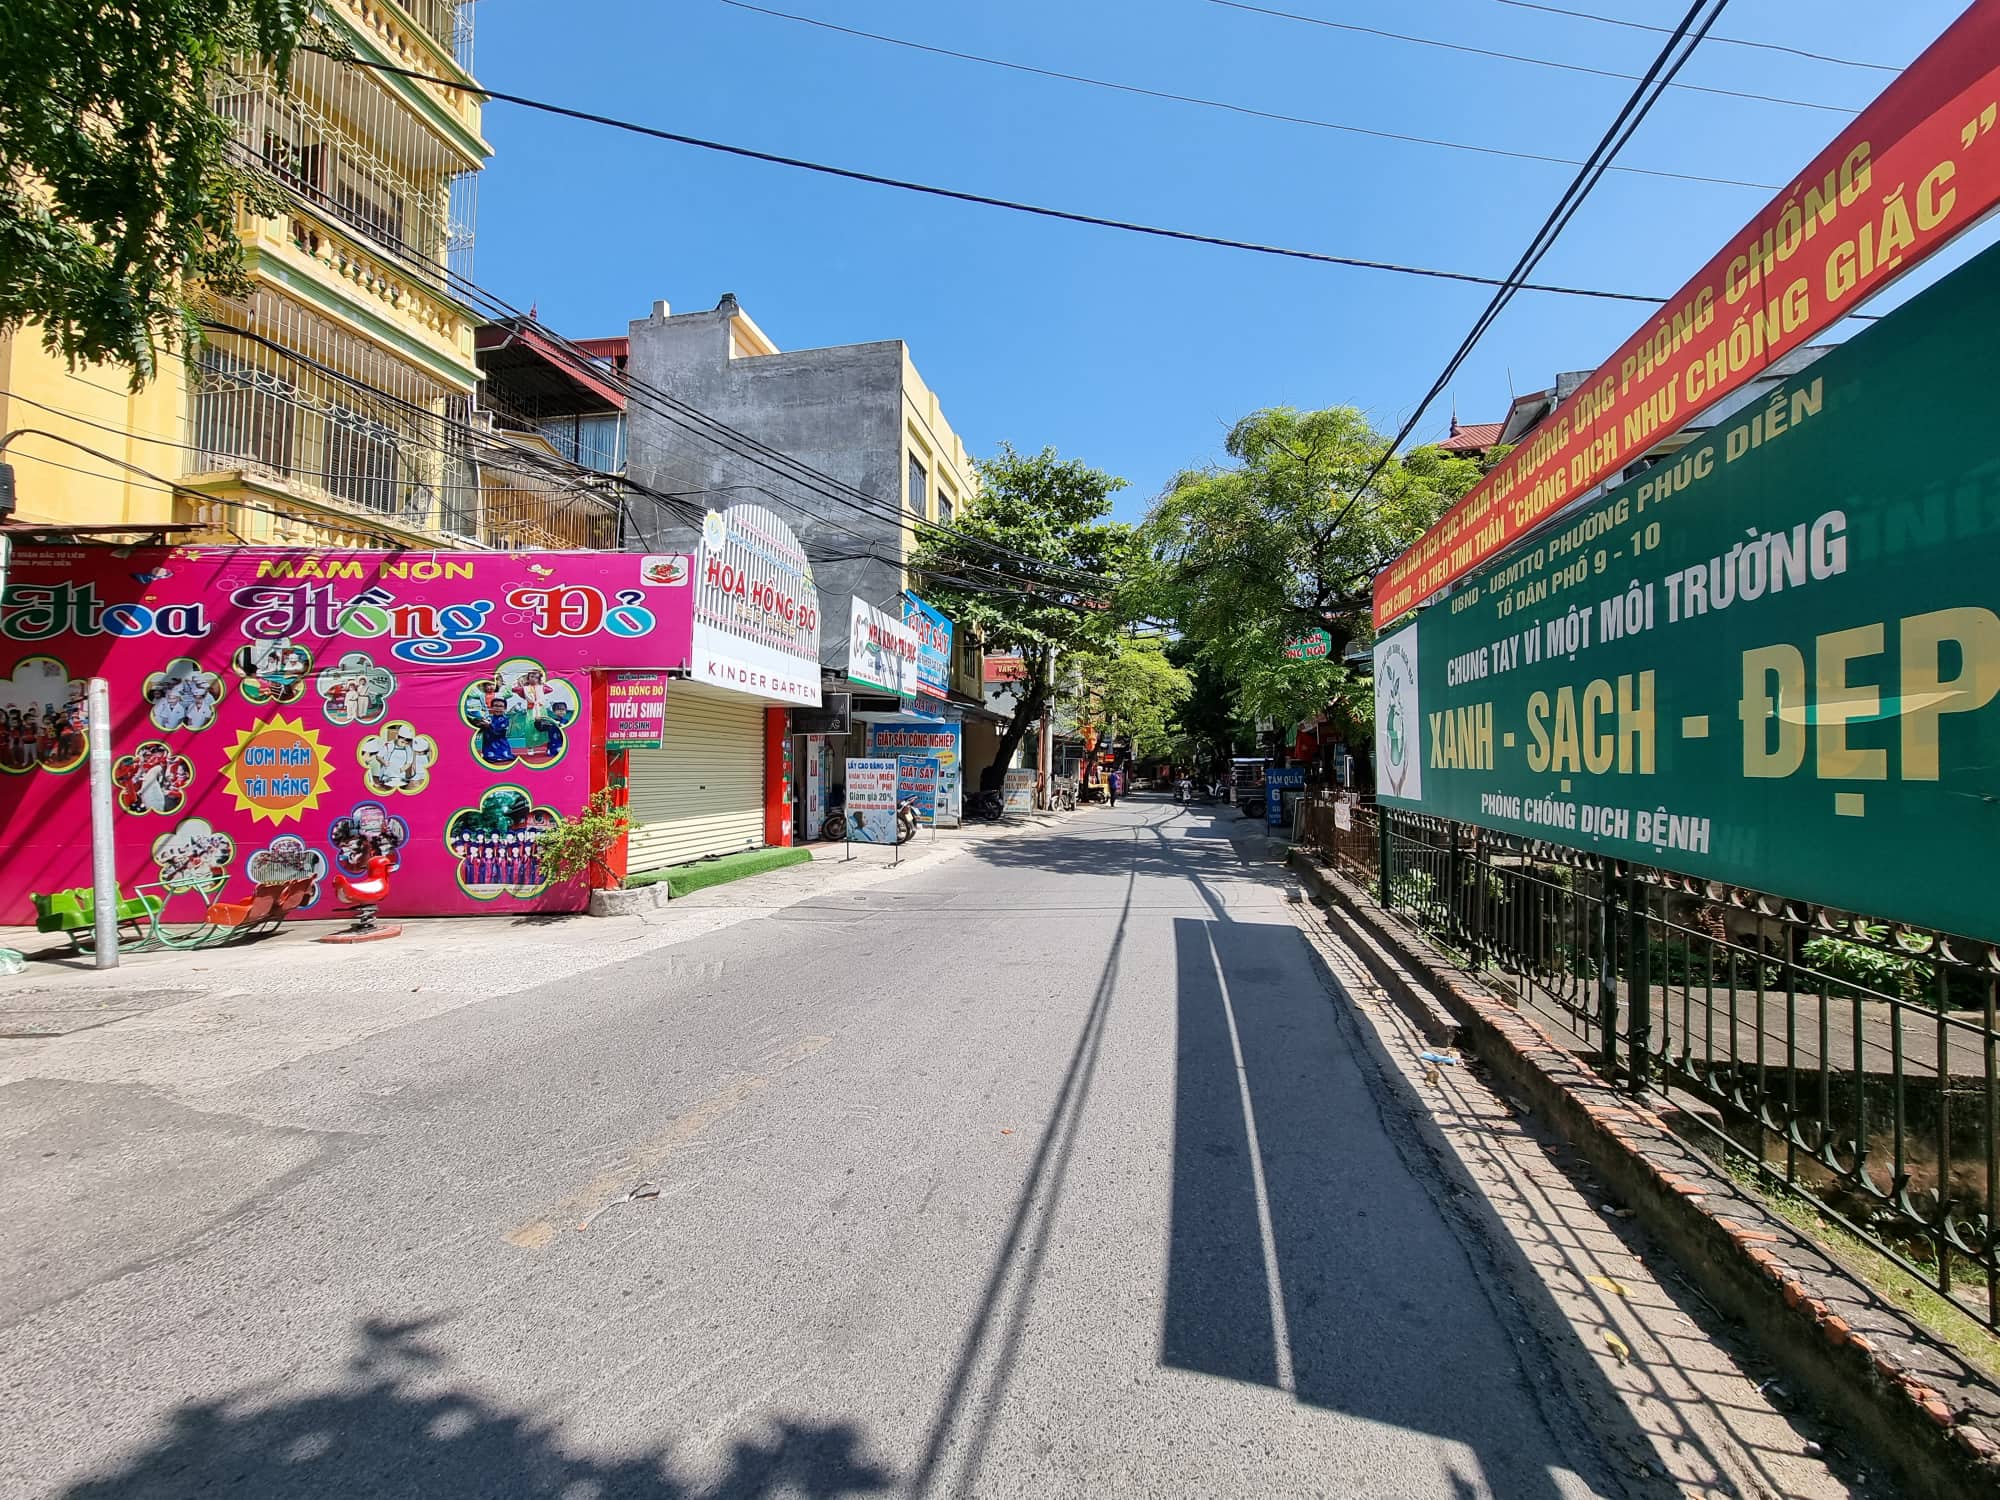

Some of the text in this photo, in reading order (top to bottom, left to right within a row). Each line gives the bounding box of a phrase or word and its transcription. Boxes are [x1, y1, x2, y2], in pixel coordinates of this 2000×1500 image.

[1423, 534, 1440, 562] TÍCH
[1441, 515, 1460, 546] CỰC
[1461, 487, 1491, 531] THAM
[1493, 468, 1514, 504] GIA
[1517, 416, 1569, 485] HƯỞNG
[1574, 376, 1615, 435] ỨNG
[1622, 286, 1714, 397] PHÒNG
[1725, 141, 1871, 304] CHỐNG
[1418, 573, 1427, 596] 19
[1429, 557, 1448, 588] THEO
[1450, 538, 1473, 573] TINH
[1475, 513, 1505, 556] THẦN
[1571, 425, 1618, 489] DỊCH
[1624, 372, 1679, 450] NHƯ
[1685, 277, 1809, 404] CHỐNG
[1452, 587, 1479, 615] UBND
[1490, 549, 1544, 594] UBMTTQ
[1549, 496, 1629, 561] PHƯỜNG
[1637, 446, 1714, 512] PHÚC
[1726, 377, 1823, 464] DIỄN
[256, 555, 474, 579] MẦM NON
[706, 555, 746, 599] HOA
[752, 575, 794, 621] HỒNG
[799, 601, 816, 632] ĐỎ
[1446, 647, 1488, 687] CHUNG
[1491, 633, 1520, 673] TAY
[1524, 621, 1541, 664] VÌ
[1546, 604, 1593, 661] MỘT
[1600, 579, 1654, 644] MÔI
[1664, 509, 1847, 623] TRƯỜNG
[1497, 588, 1513, 619] TỔ
[1516, 579, 1547, 611] DÂN
[1551, 549, 1588, 598] PHỐ
[1594, 550, 1607, 574] 9
[1630, 521, 1661, 558] 10
[1, 580, 211, 641] Hoa
[229, 582, 503, 665] Hồng
[505, 583, 657, 639] Đỏ
[609, 696, 663, 719] TUYỂN SINH
[610, 685, 626, 696] HOA
[708, 660, 816, 699] KINDER GARTEN
[1429, 606, 2000, 817] XANH - SẠCH - ĐẸP
[634, 721, 651, 730] SINH
[908, 730, 928, 748] CÔNG
[1481, 790, 1521, 820] PHÒNG
[1524, 792, 1576, 830] CHỐNG
[1581, 804, 1629, 841] DỊCH
[1636, 805, 1710, 854] BỆNH
